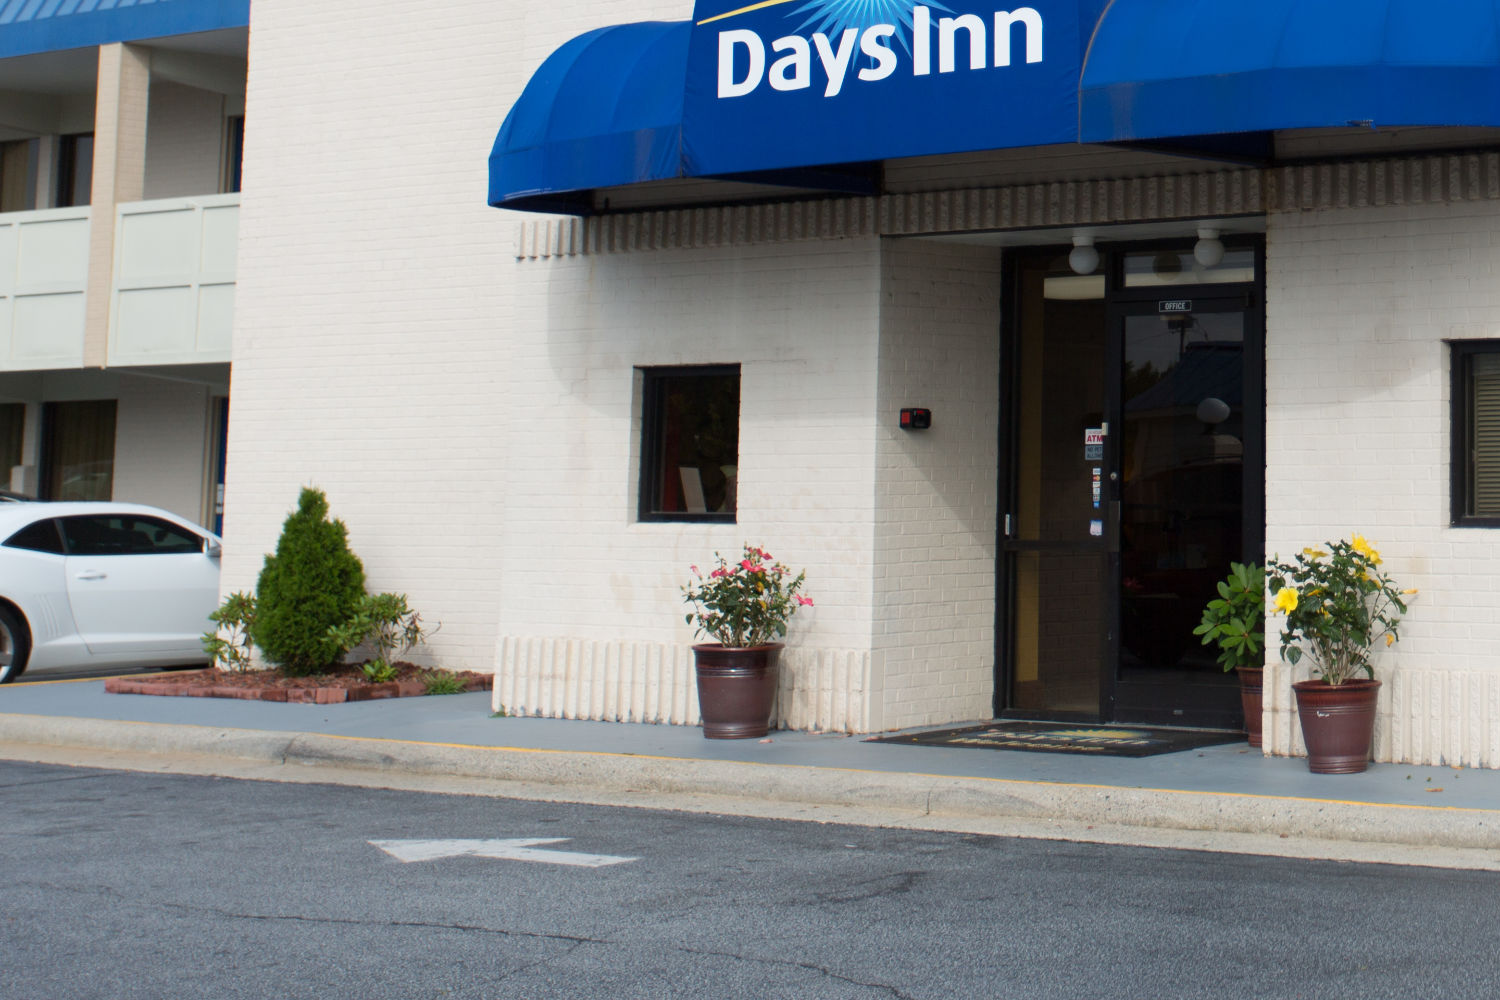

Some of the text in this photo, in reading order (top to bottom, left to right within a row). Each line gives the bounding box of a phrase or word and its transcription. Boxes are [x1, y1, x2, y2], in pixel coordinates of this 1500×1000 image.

[718, 6, 1042, 98] Days Inn
[1165, 302, 1186, 311] OFFICE
[1087, 435, 1104, 443] ATM
